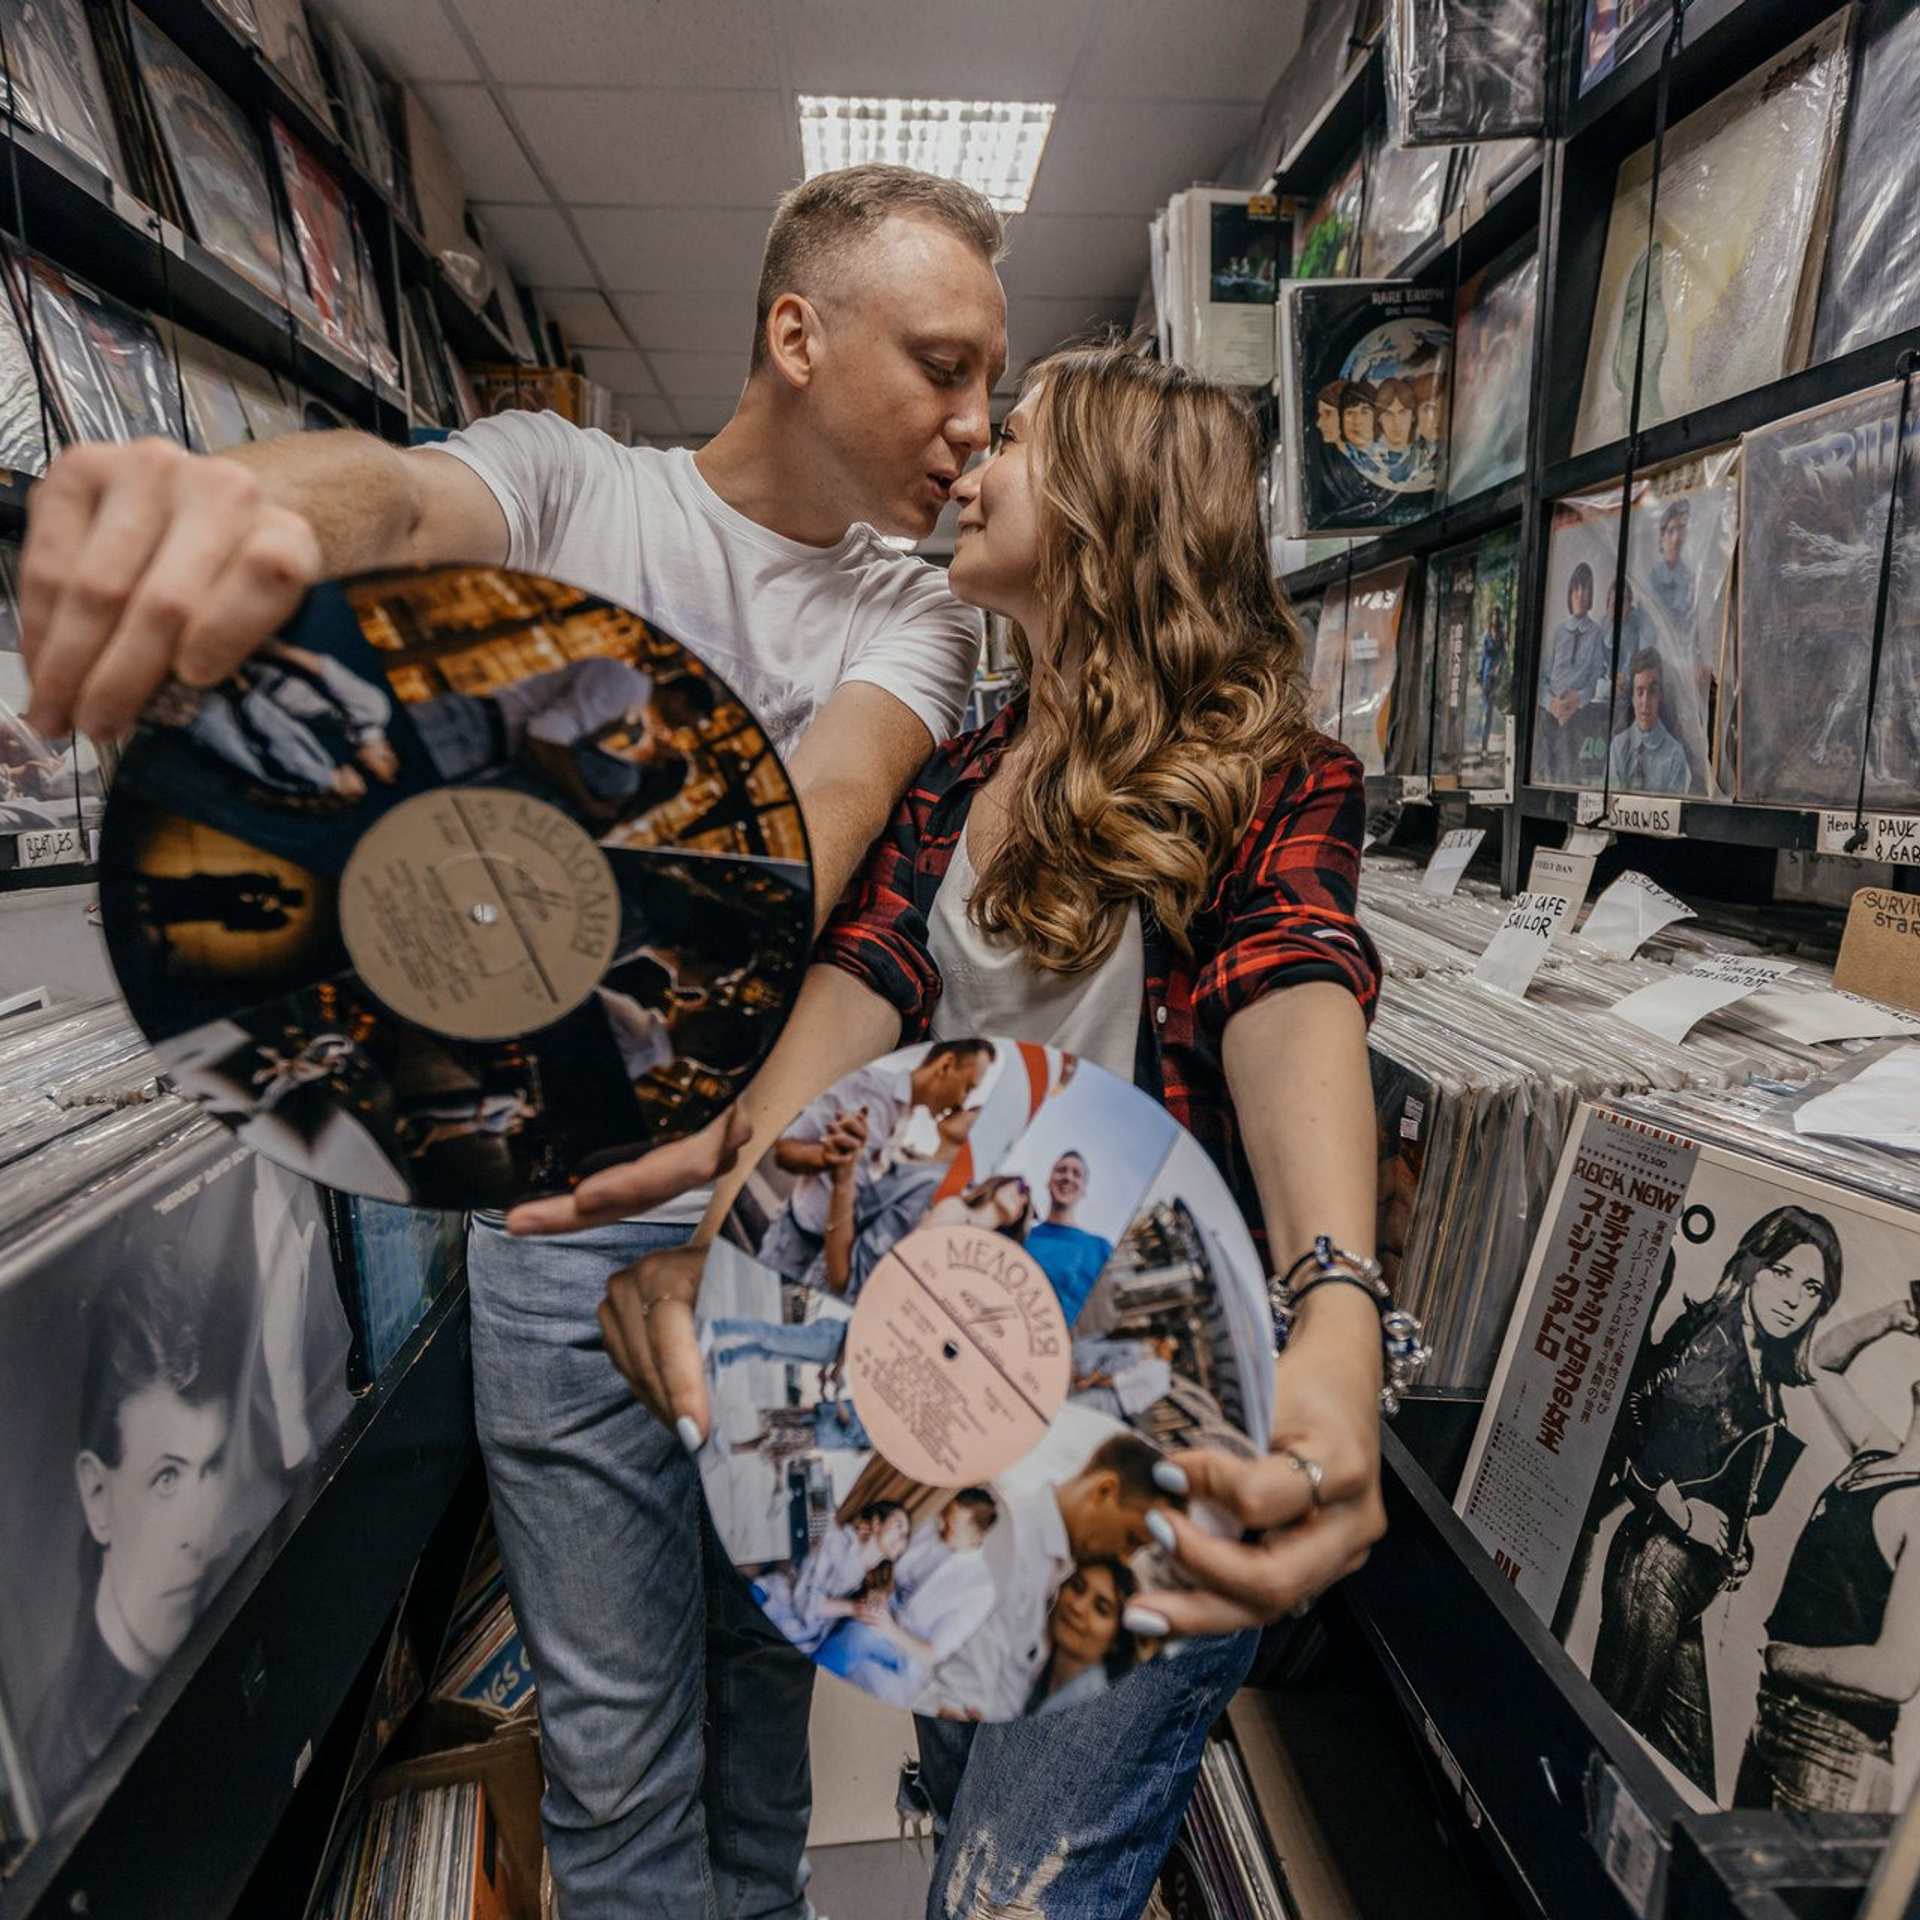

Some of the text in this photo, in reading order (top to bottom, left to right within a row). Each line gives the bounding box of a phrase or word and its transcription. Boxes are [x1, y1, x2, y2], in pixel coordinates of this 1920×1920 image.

[1371, 291, 1402, 305] RARE
[25, 831, 74, 864] BEATLES
[1534, 896, 1567, 917] CAFE
[1503, 912, 1553, 940] SAILOR
[1573, 1157, 1681, 1215] ROCK NOW
[946, 1238, 1061, 1358] МЕЛОДИЯ
